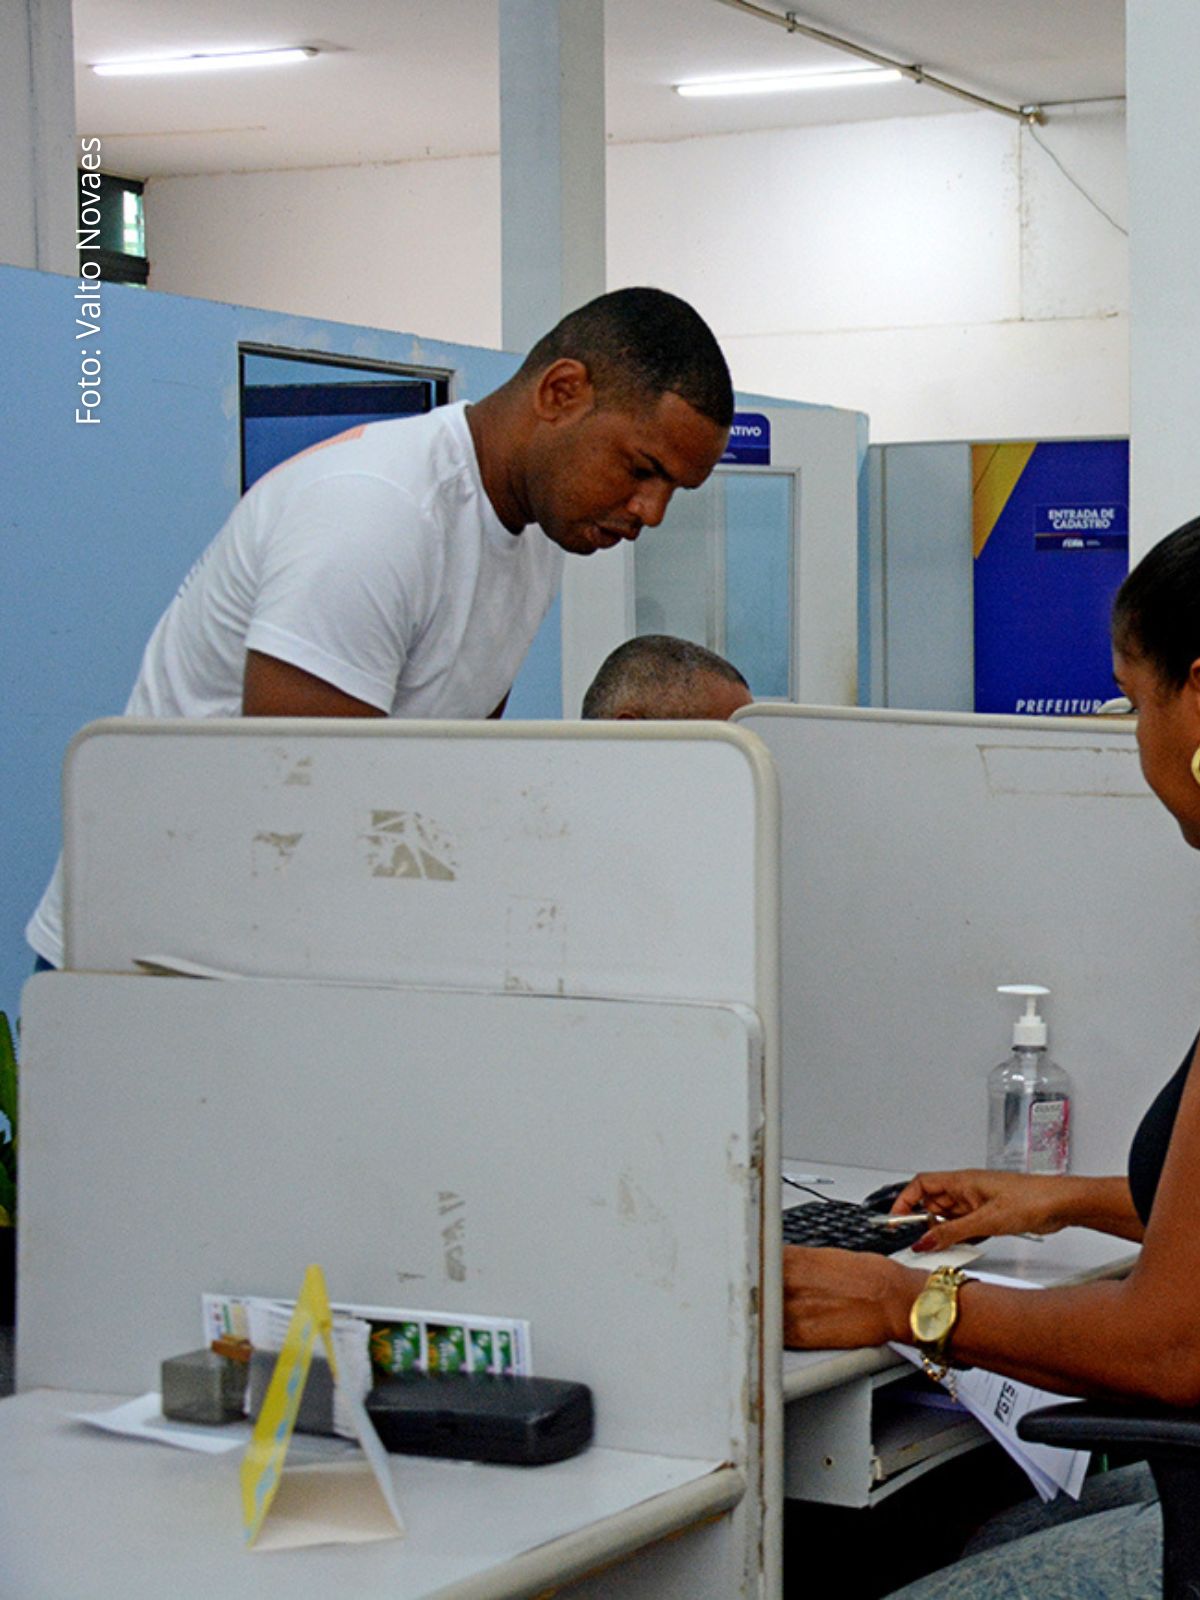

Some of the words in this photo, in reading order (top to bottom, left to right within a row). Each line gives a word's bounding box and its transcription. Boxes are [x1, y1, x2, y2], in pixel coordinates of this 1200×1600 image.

[1048, 508, 1099, 520] ENTRADA
[1101, 508, 1115, 519] DE
[1053, 518, 1111, 530] CADASTRO
